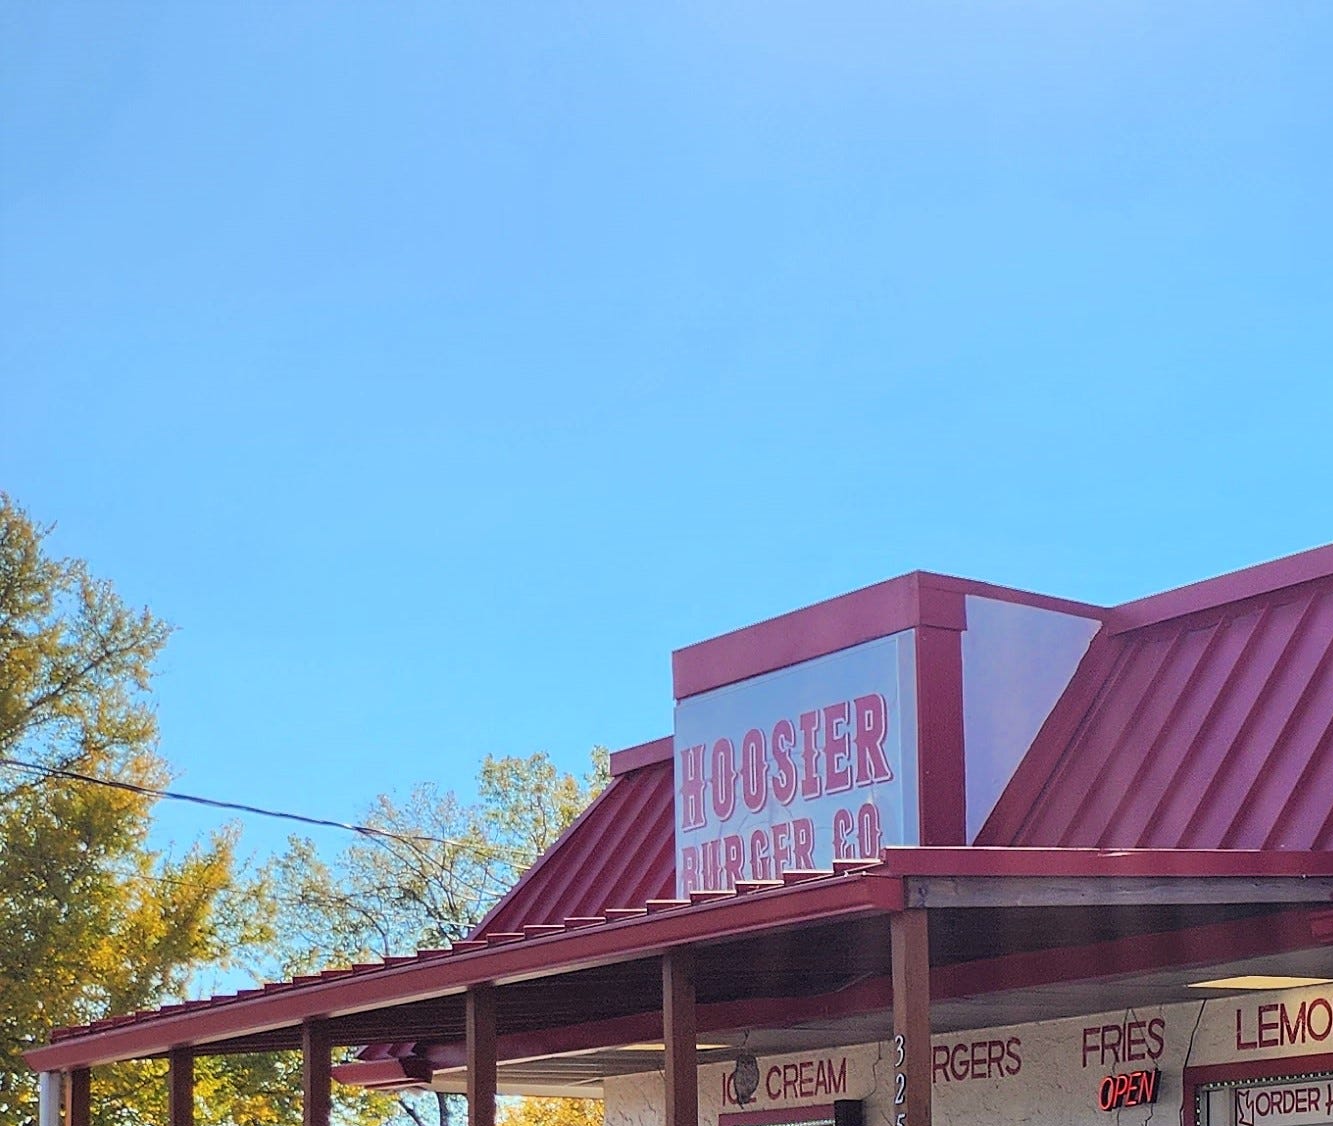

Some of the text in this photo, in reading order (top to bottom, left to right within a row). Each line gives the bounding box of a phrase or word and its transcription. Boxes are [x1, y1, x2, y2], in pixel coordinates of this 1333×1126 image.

[681, 693, 892, 832] HOOSIER
[682, 802, 882, 894] BURGER CO
[721, 1036, 1022, 1107] IC CREAM RGERS
[1082, 1017, 1165, 1068] FRIES
[1099, 1070, 1158, 1112] OPEN
[1254, 1087, 1320, 1117] ORDER
